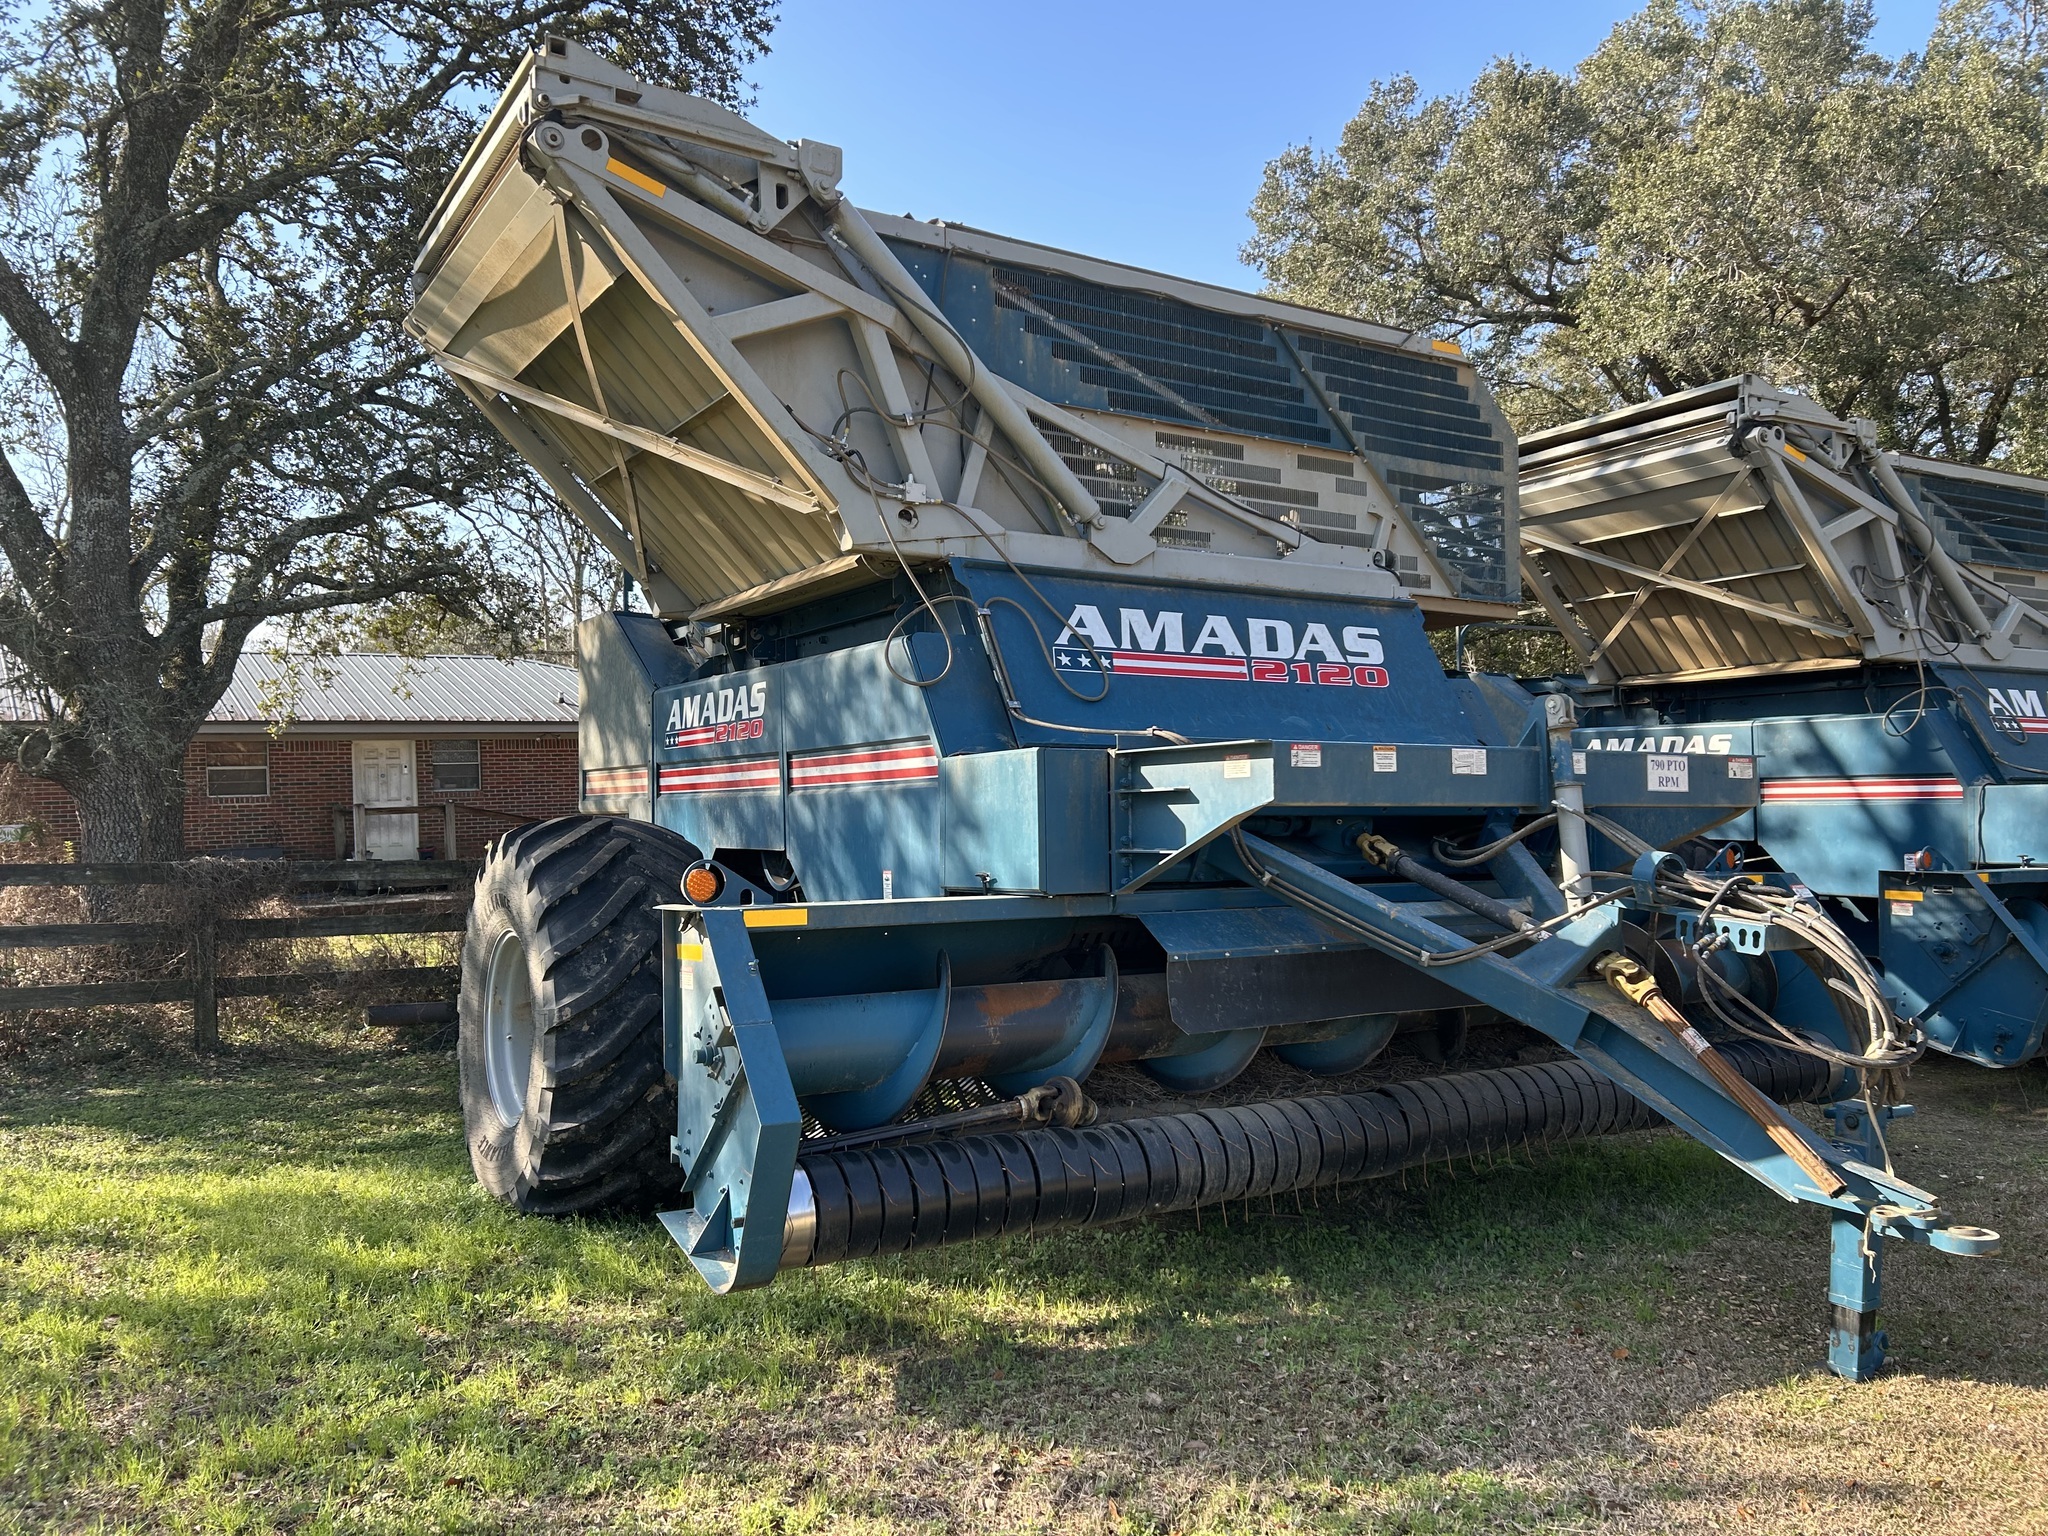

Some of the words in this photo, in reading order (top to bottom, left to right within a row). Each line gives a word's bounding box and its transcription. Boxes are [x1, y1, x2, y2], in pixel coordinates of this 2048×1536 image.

[1053, 604, 1385, 665] AMADAS
[1252, 659, 1390, 688] 2120
[666, 681, 767, 731] AMADAS
[1987, 687, 2048, 717] AM
[715, 718, 764, 743] 2120
[1651, 759, 1665, 771] 790
[1667, 759, 1686, 772] PTO
[1658, 776, 1680, 788] RPM
